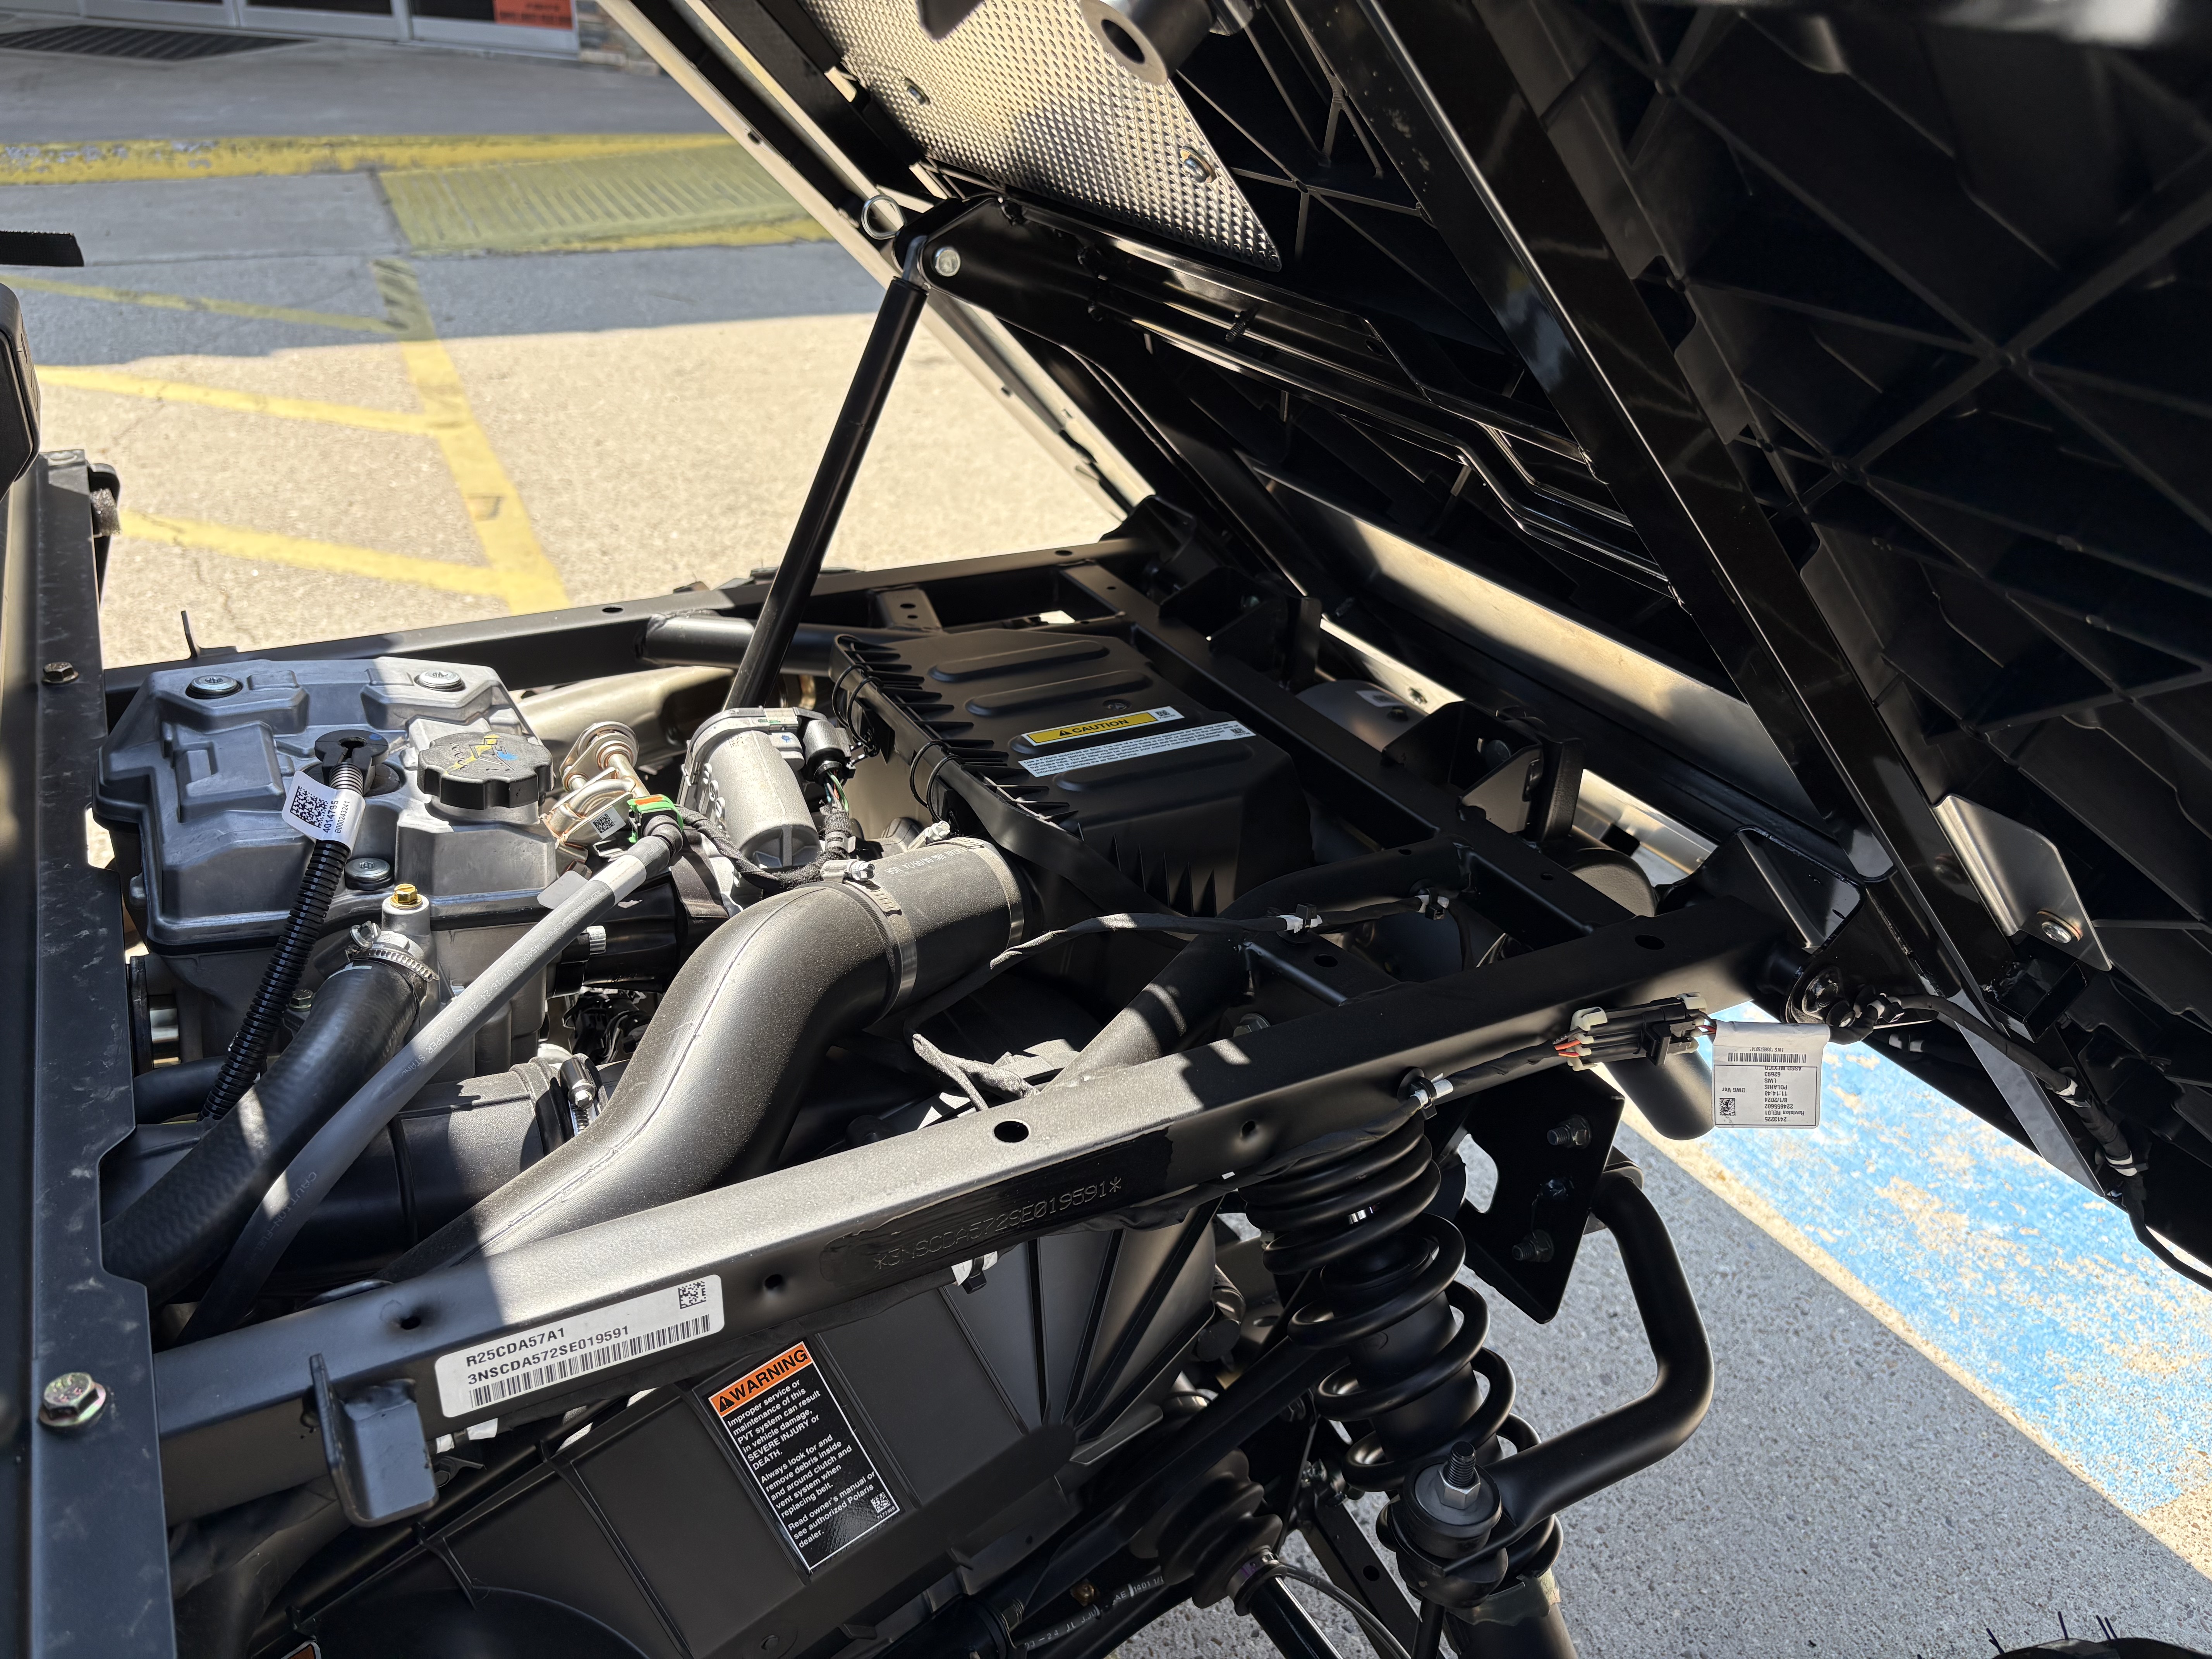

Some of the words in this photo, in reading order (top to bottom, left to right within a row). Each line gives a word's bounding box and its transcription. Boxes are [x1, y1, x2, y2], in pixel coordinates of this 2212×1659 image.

[1072, 719, 1129, 734] CAUTION
[323, 800, 339, 833] 4014795
[335, 801, 350, 833] B000243241
[480, 969, 514, 1001] 07/16/24
[457, 1001, 479, 1024] 21:56
[426, 1027, 453, 1053] COOPER
[466, 1327, 565, 1367] R25CDA57A1
[467, 1325, 630, 1386] 3NSCDA572SE019591
[732, 1348, 809, 1402] WARNING
[727, 1402, 762, 1427] Improper
[763, 1386, 791, 1406] service
[791, 1379, 800, 1388] or
[733, 1403, 781, 1436] maintenance
[781, 1396, 791, 1406] of
[790, 1388, 806, 1401] this
[737, 1429, 754, 1444] PVT
[755, 1414, 783, 1434] system
[783, 1405, 798, 1417] can
[798, 1390, 821, 1408] result
[742, 1445, 752, 1453] in
[751, 1428, 780, 1447] vehicle
[780, 1409, 813, 1431] damage,
[747, 1437, 781, 1462] SEVERE
[780, 1419, 809, 1442] INJURY
[811, 1414, 819, 1423] or
[752, 1449, 783, 1471] DEATH.
[761, 1463, 788, 1484] Always
[787, 1452, 806, 1466] look
[805, 1444, 817, 1455] for
[818, 1434, 833, 1448] and
[765, 1471, 794, 1492] remove
[794, 1456, 819, 1474] debris
[818, 1441, 842, 1459] inside
[771, 1487, 786, 1501] and
[786, 1469, 814, 1491] around
[813, 1456, 837, 1474] clutch
[837, 1444, 852, 1458] and
[775, 1495, 793, 1509] vent
[793, 1478, 821, 1498] system
[820, 1464, 842, 1480] when
[781, 1492, 817, 1518] replacing
[815, 1482, 834, 1496] belt.
[787, 1514, 809, 1531] Read
[809, 1496, 839, 1518] owner's
[839, 1476, 867, 1499] manual
[867, 1471, 875, 1480] or
[793, 1528, 808, 1540] see
[808, 1500, 848, 1530] authorized
[847, 1484, 874, 1504] Polaris
[876, 1505, 895, 1520] 7177469
[799, 1529, 824, 1548] dealer.
